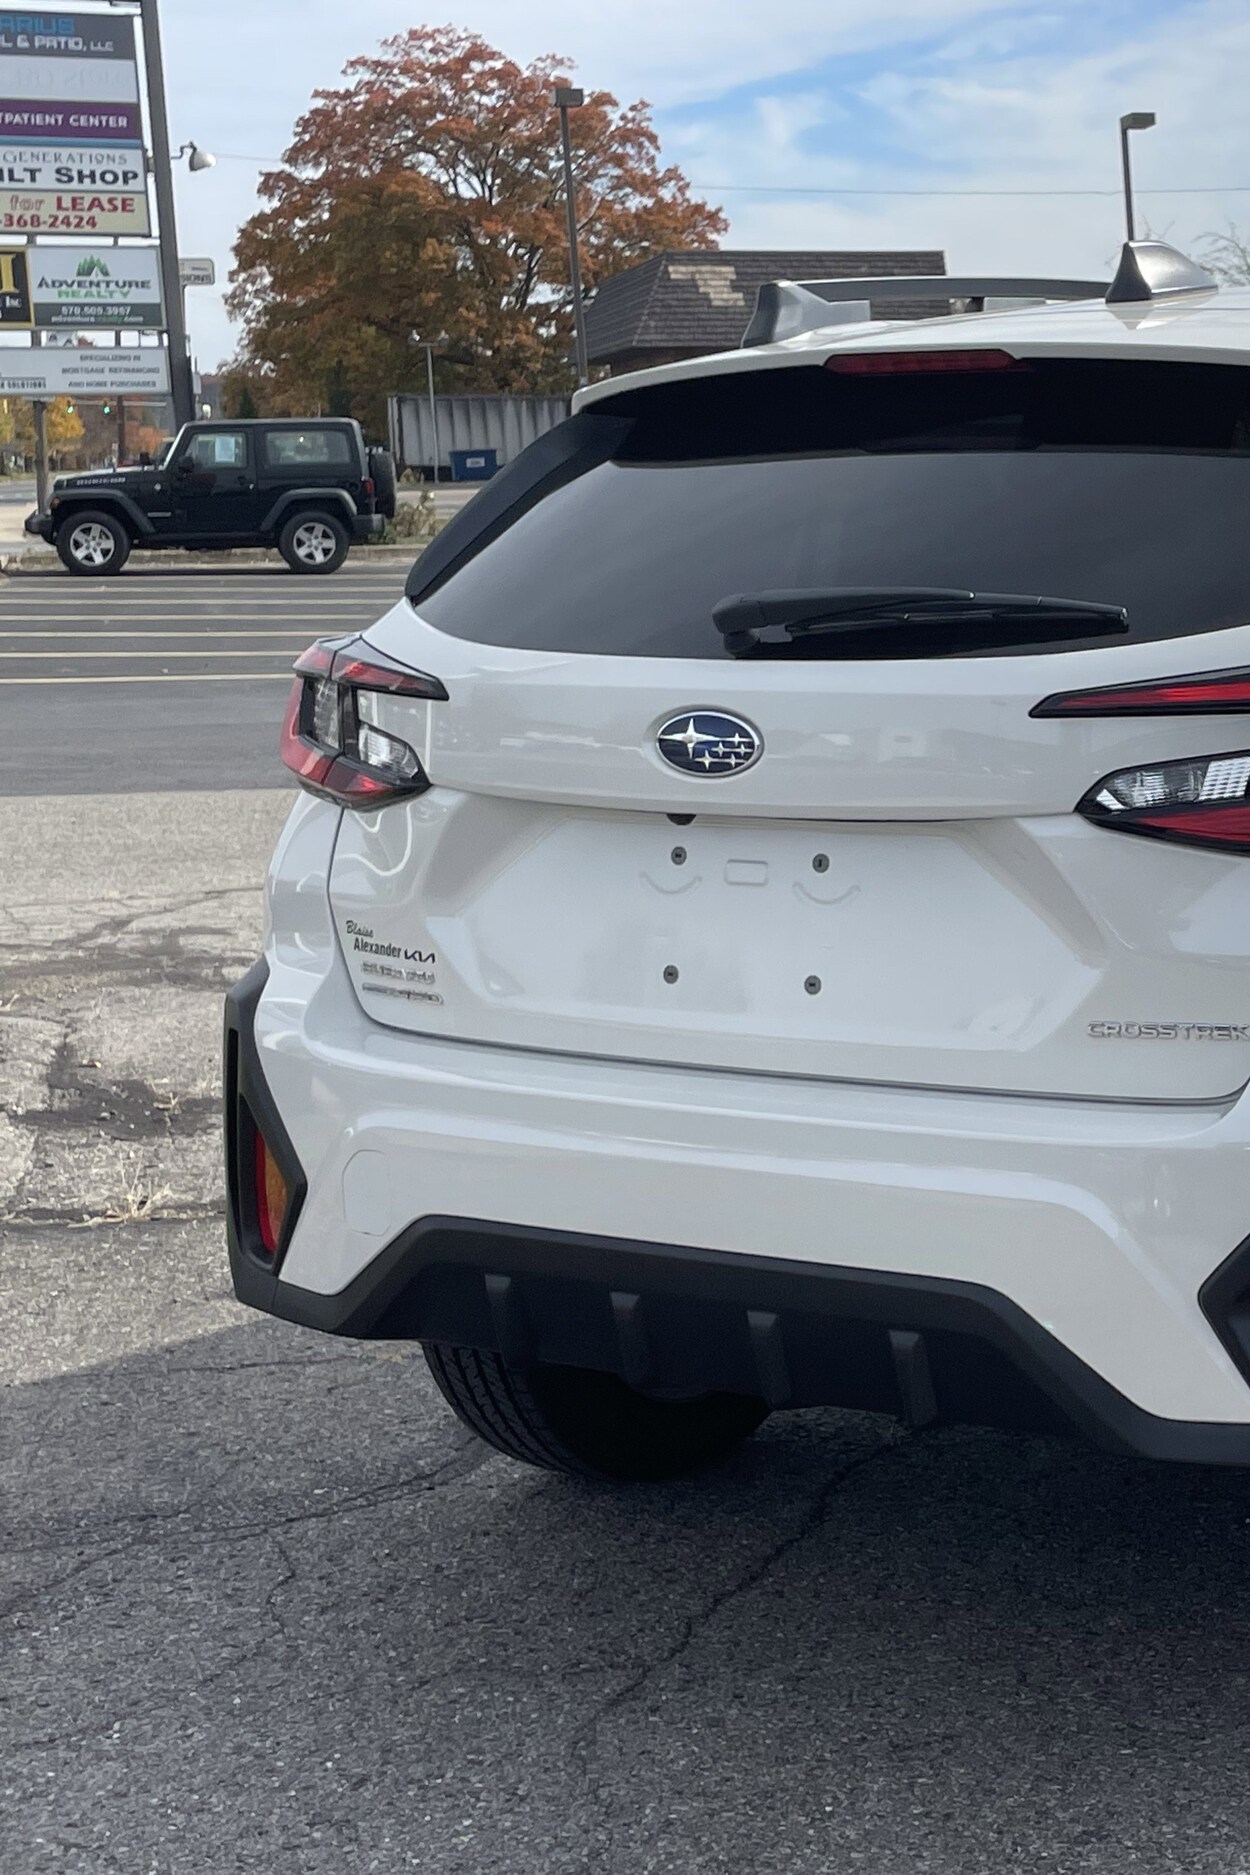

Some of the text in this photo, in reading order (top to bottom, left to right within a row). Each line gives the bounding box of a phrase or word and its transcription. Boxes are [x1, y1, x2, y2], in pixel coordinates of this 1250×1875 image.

[69, 114, 128, 128] CENTER
[3, 151, 128, 165] GENERATIONS
[55, 167, 139, 186] SHOP
[10, 195, 135, 213] for LEASE
[38, 276, 152, 289] ADVENTURE
[57, 290, 130, 299] REALTY
[353, 937, 402, 958] Alexander
[1087, 1020, 1250, 1042] CROSSTREK
